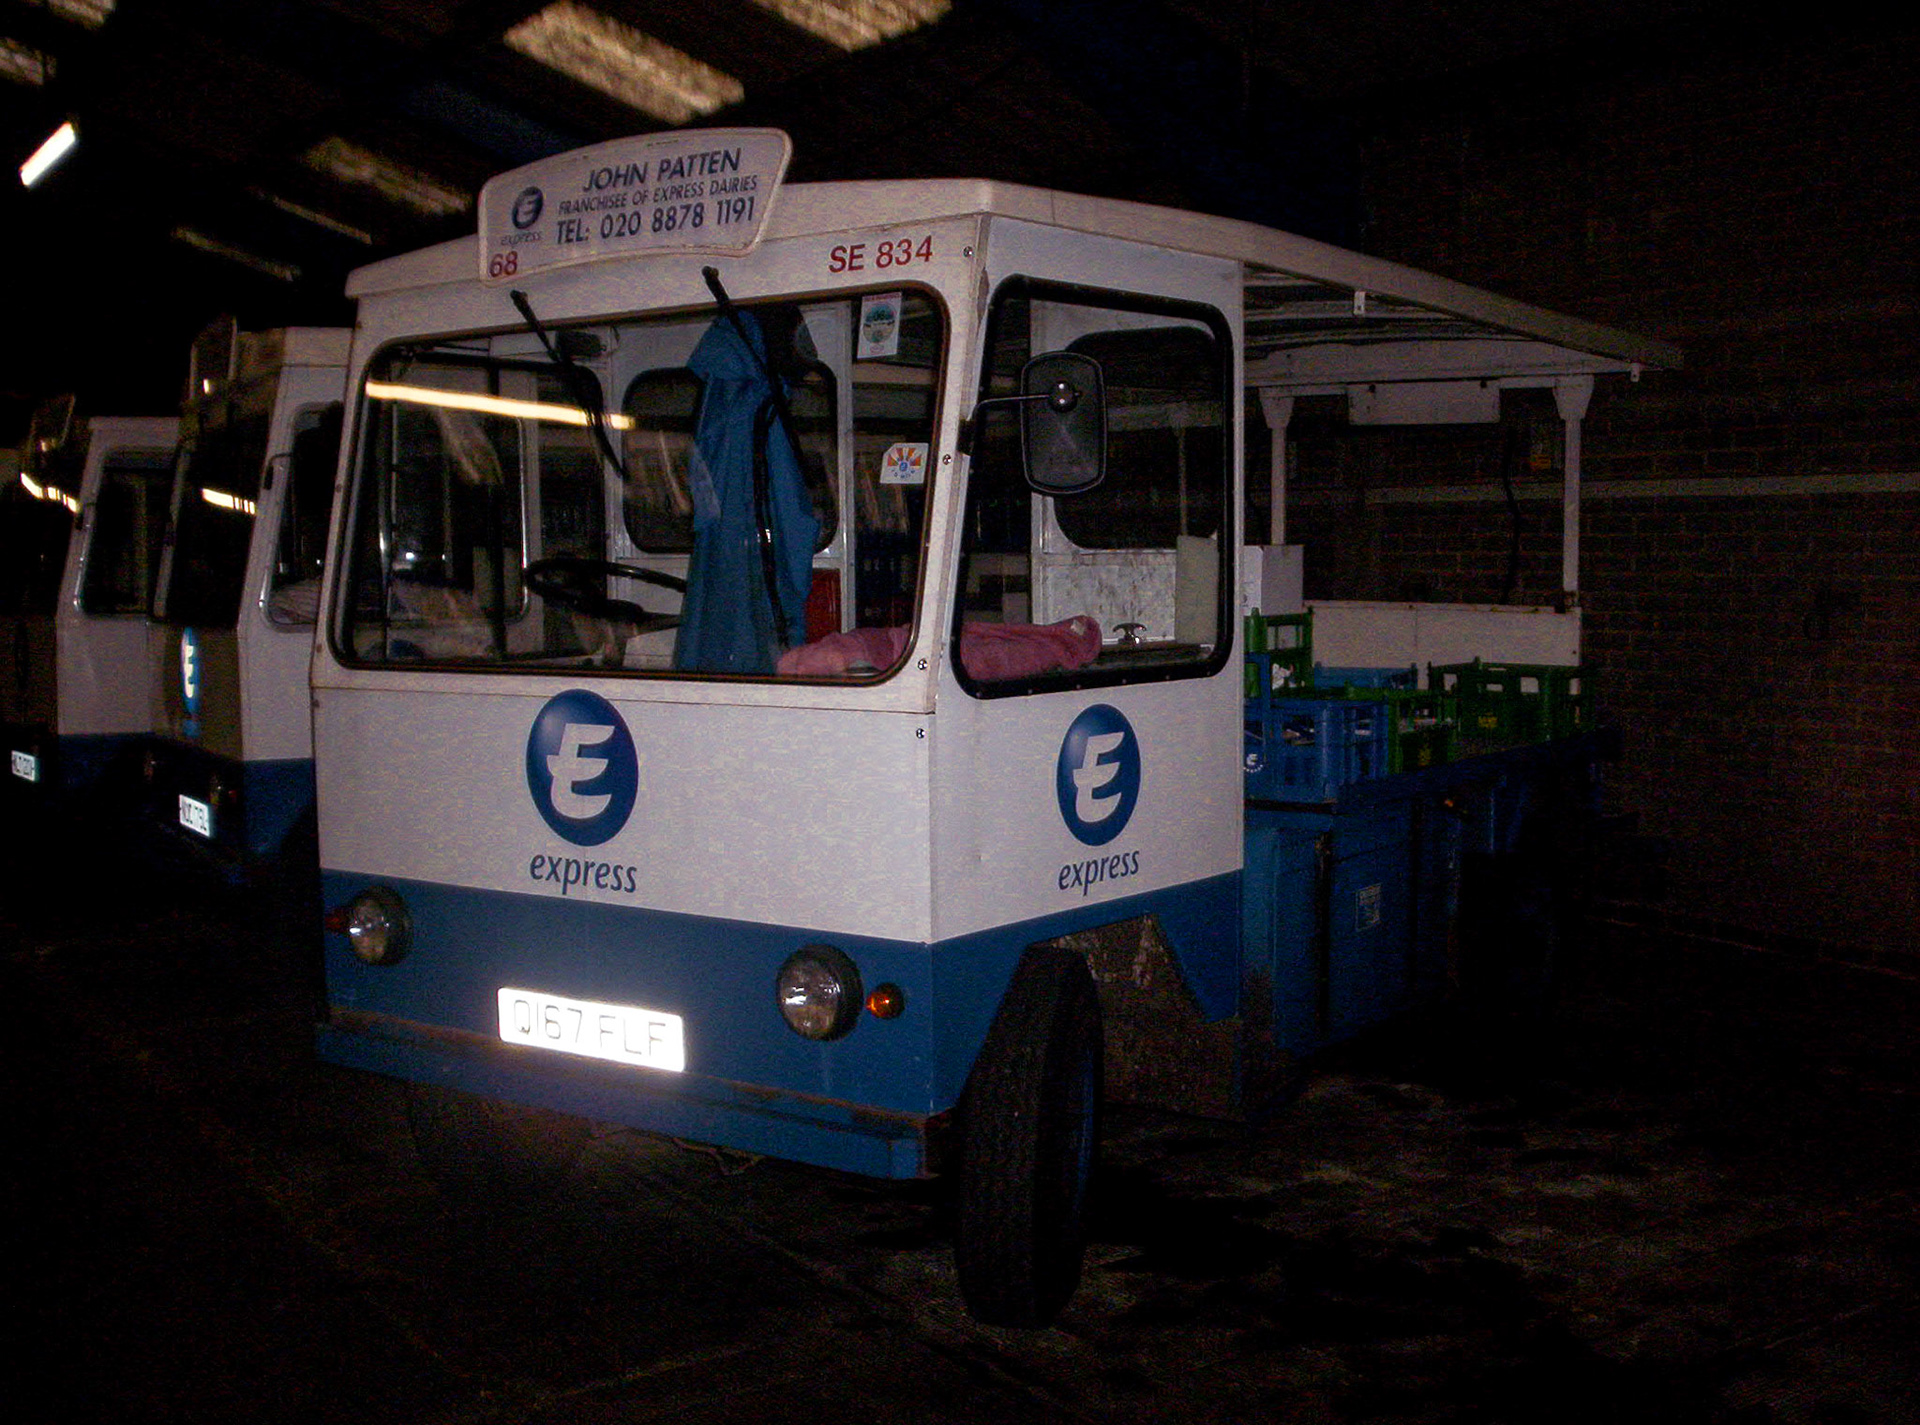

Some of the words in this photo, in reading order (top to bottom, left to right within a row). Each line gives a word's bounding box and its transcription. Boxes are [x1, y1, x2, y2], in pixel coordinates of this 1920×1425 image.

[583, 162, 648, 192] JOHN
[657, 148, 741, 181] PATTEN
[558, 192, 627, 215] FRANCHISEE
[632, 189, 649, 206] OF
[653, 181, 704, 203] EXPRESS
[709, 175, 758, 196] DAIRIES
[556, 218, 591, 245] TEL:
[600, 211, 641, 239] 020
[651, 202, 704, 233] 8878
[716, 196, 755, 225] 1191
[489, 251, 518, 277] 68
[829, 244, 866, 273] SE
[876, 235, 932, 268] 834
[529, 854, 638, 895] express
[1058, 850, 1140, 896] express
[514, 999, 583, 1044] Q167
[599, 1015, 666, 1055] FLF
